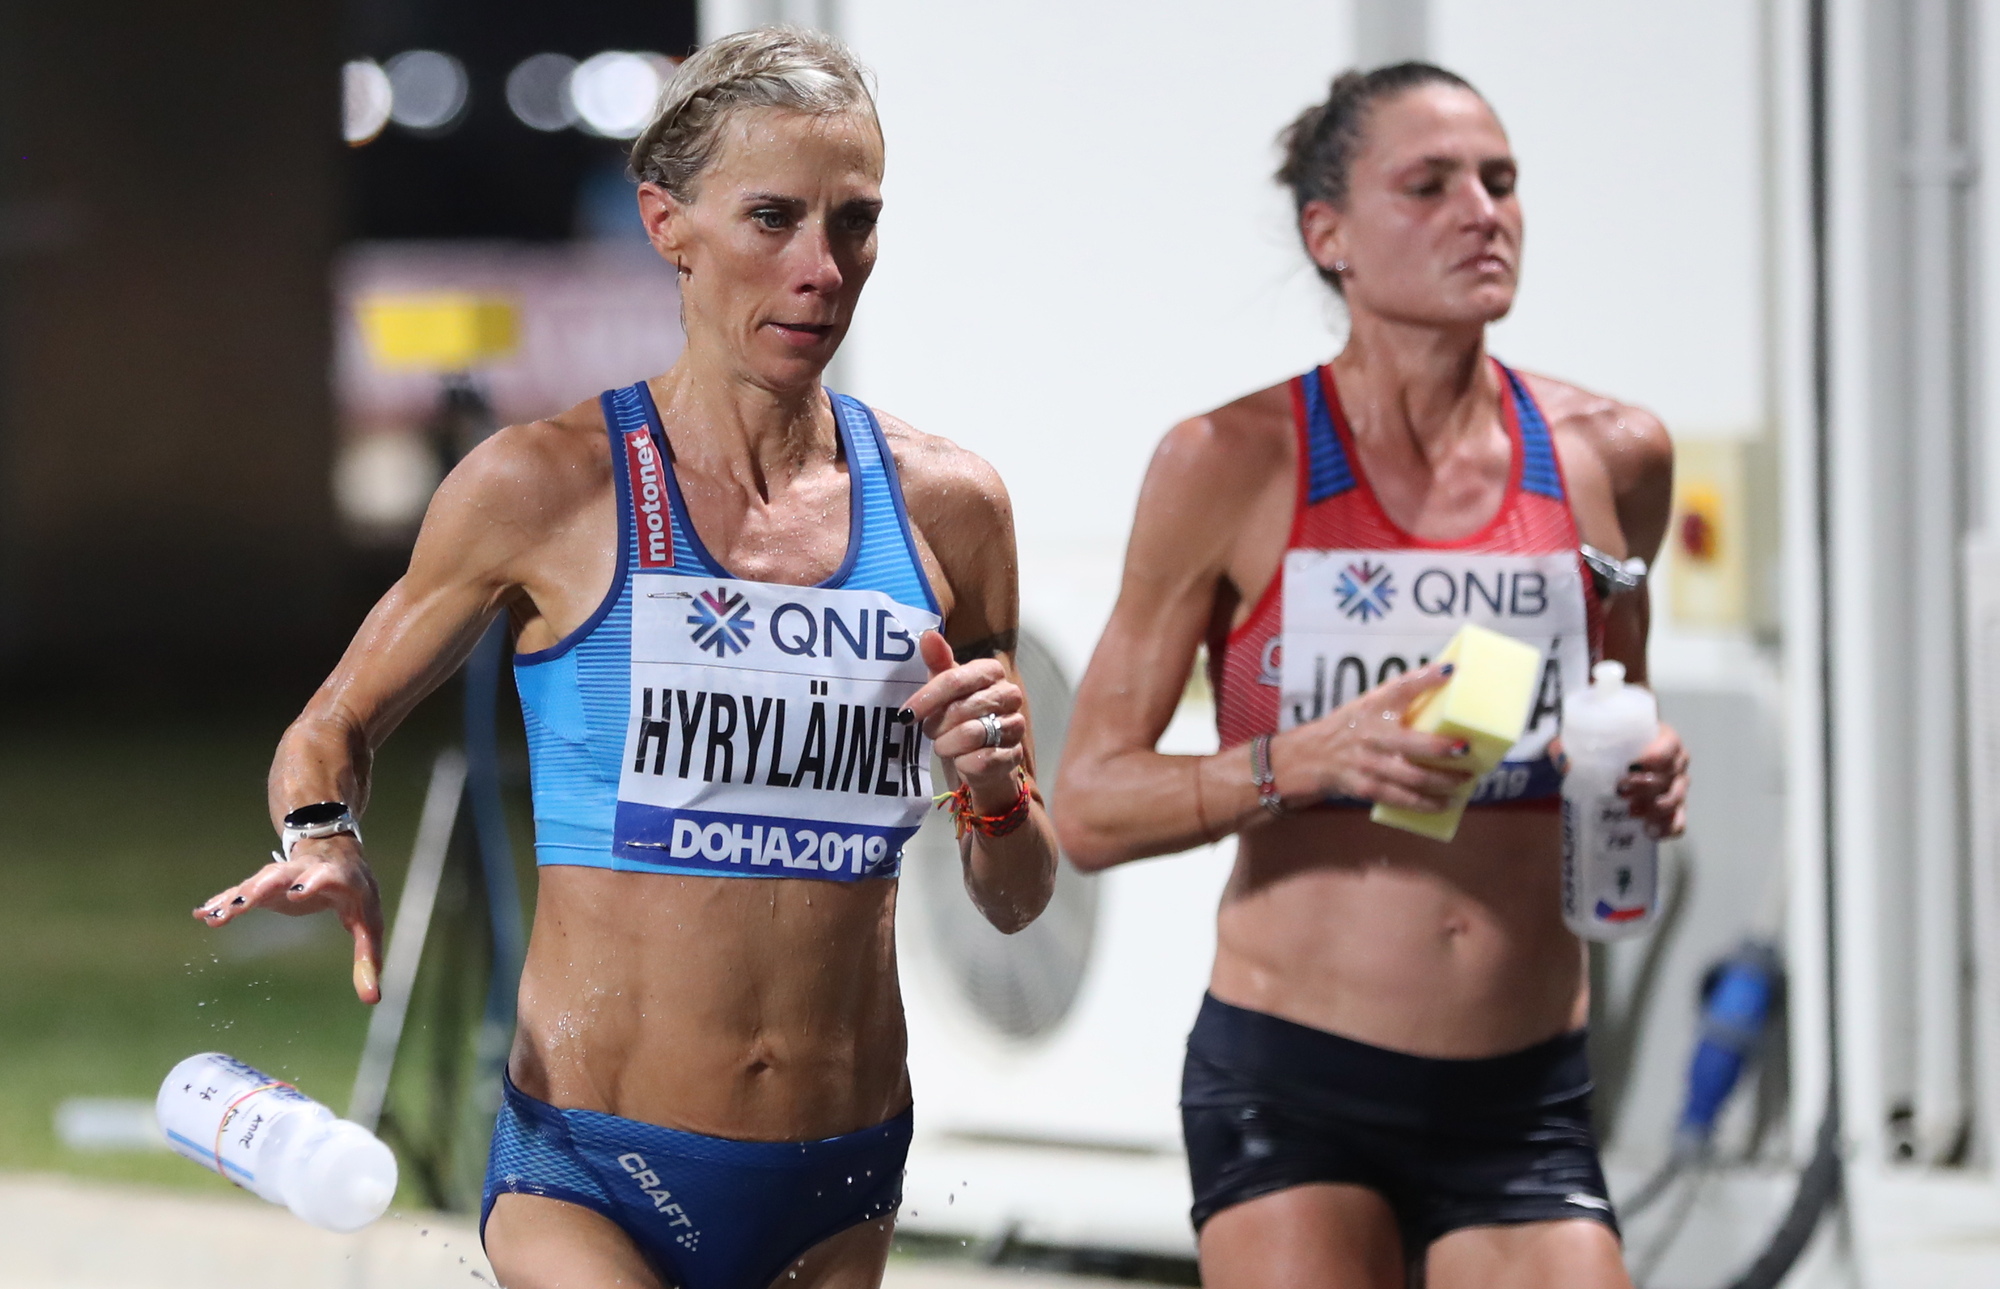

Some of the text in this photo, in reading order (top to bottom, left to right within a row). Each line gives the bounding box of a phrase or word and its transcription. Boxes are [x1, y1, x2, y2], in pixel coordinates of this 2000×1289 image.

[631, 434, 666, 562] motonet
[1413, 569, 1549, 618] QNB
[769, 602, 916, 663] QNB
[634, 680, 923, 797] HYRYLÄINEN
[669, 818, 888, 874] DOHA2019
[617, 1152, 692, 1228] CRAFT
